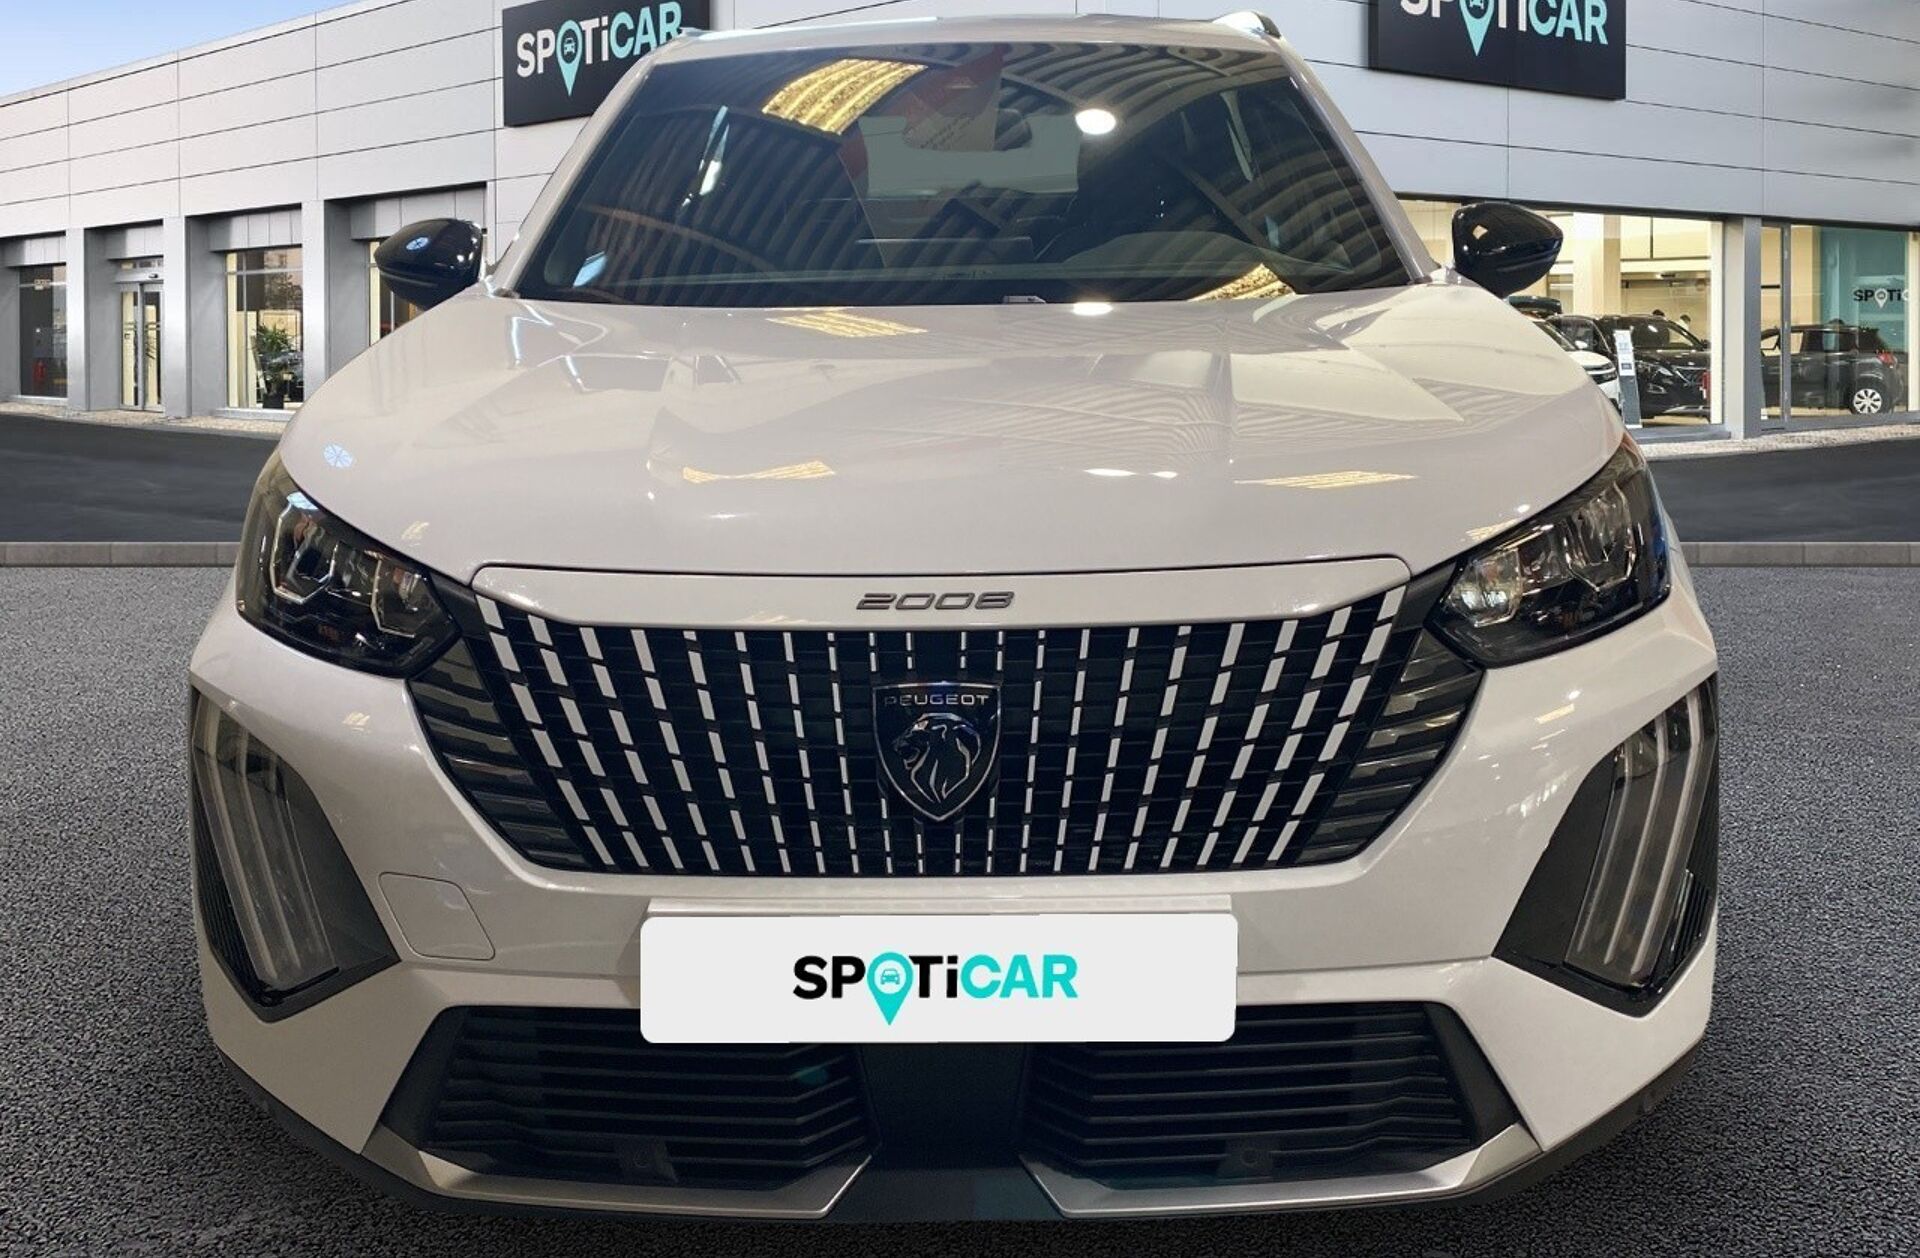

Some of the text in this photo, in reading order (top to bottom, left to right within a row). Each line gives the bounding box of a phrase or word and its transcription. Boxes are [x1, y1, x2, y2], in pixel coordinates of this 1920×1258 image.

[516, 1, 682, 96] SPOTiCAR
[856, 591, 1015, 610] 2008
[884, 694, 989, 706] PEUGEOT
